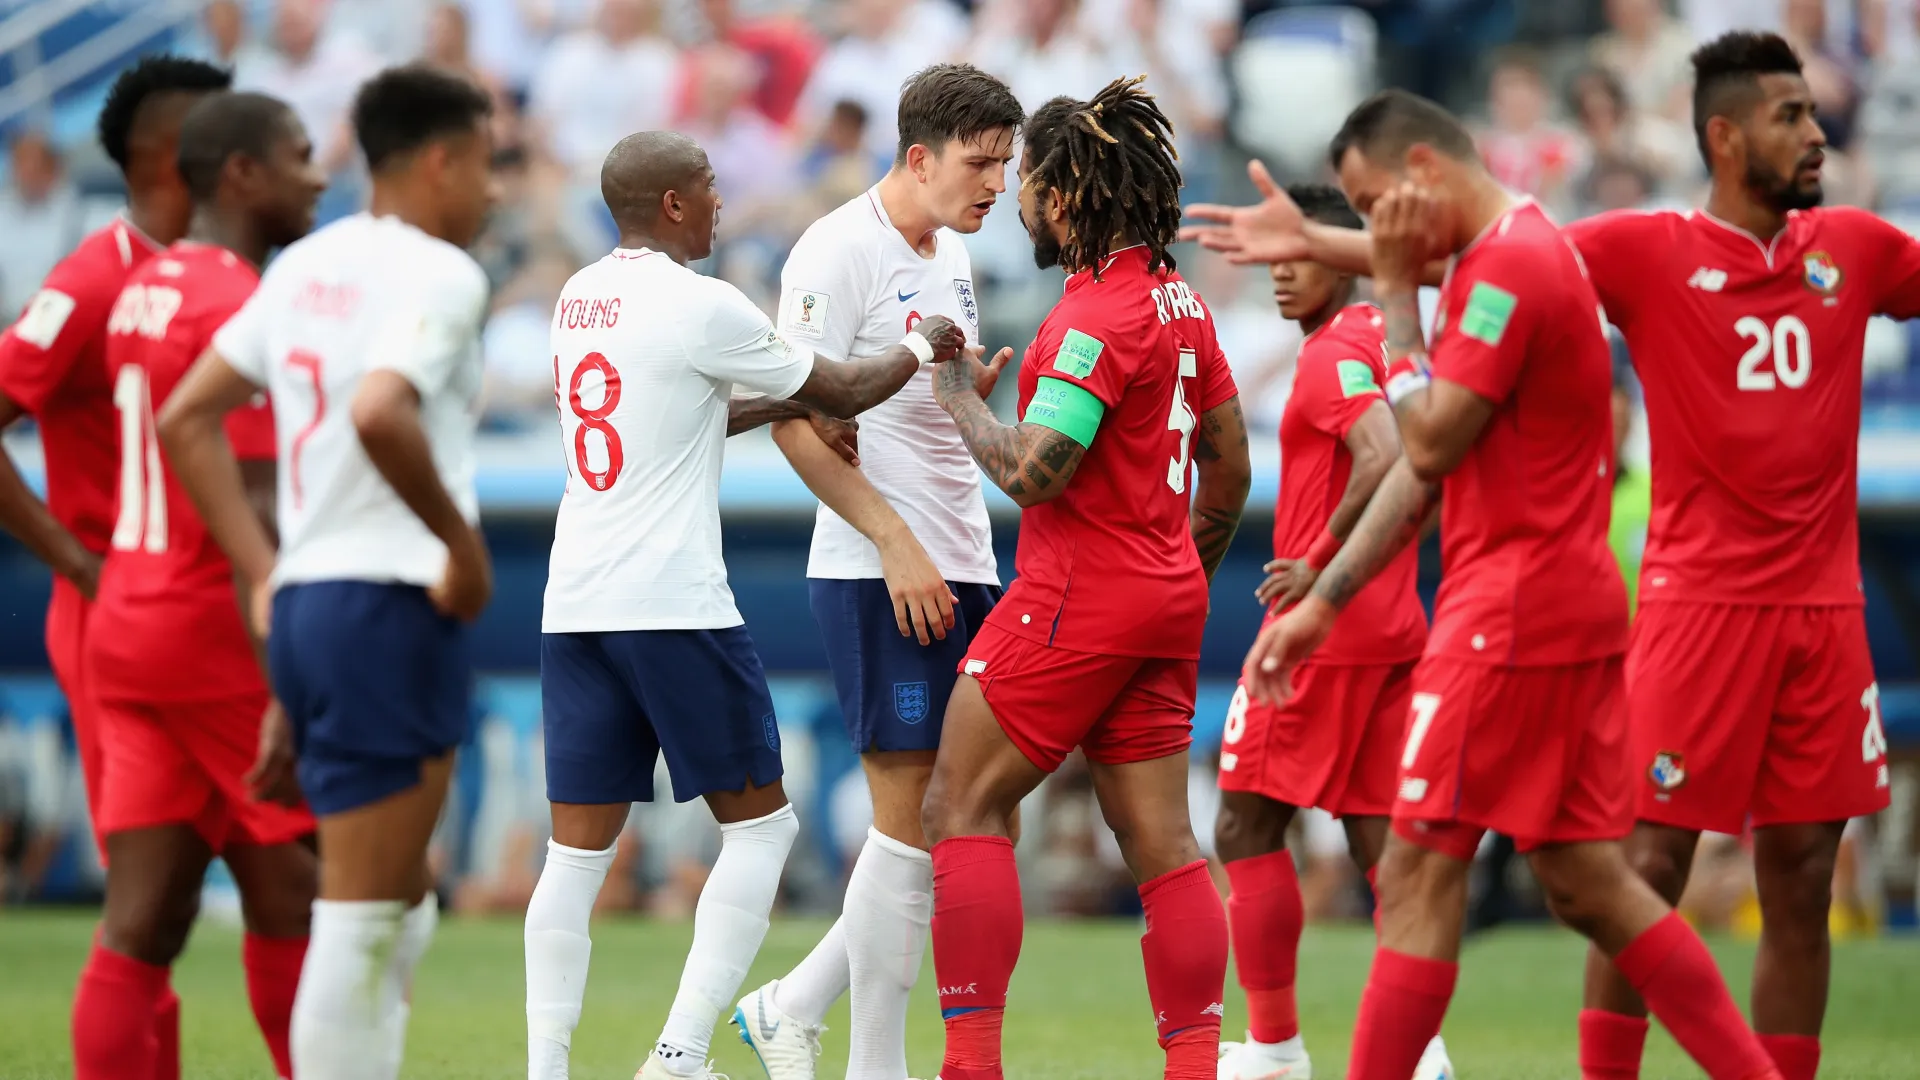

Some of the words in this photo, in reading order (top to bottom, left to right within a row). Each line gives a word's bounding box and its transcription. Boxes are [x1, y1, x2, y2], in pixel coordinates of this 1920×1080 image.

[559, 297, 621, 330] YOUNG
[1077, 360, 1090, 370] FIFA
[1733, 314, 1813, 391] 20
[286, 347, 326, 510] 7
[1033, 406, 1056, 419] FIFA
[1166, 347, 1197, 495] 5
[111, 364, 168, 553] 11
[1224, 683, 1250, 745] 8
[1401, 691, 1442, 770] 7
